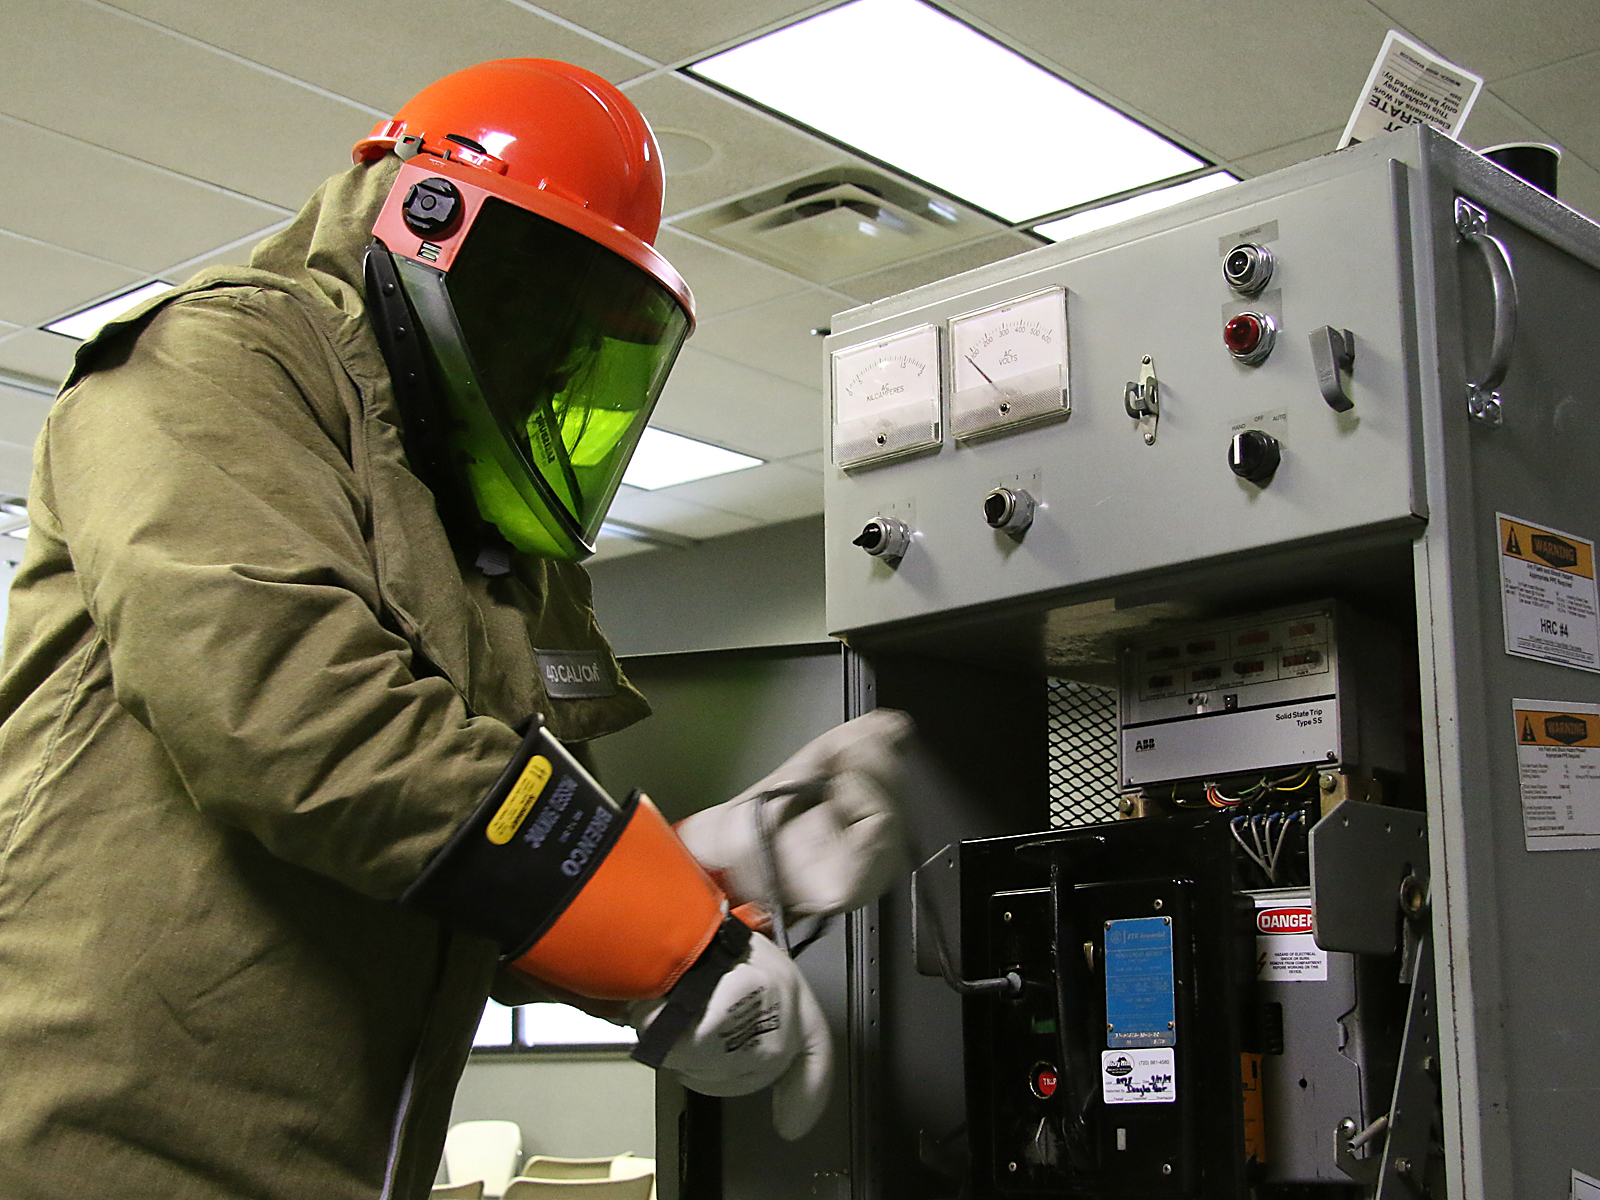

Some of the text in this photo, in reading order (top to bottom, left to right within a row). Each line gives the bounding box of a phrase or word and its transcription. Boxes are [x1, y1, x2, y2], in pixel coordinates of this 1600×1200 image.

[1382, 71, 1458, 114] only be removed by:
[1382, 80, 1449, 119] This lock/tag may
[1373, 86, 1451, 129] Electricians At Work
[971, 348, 980, 359] 100
[983, 336, 993, 347] 200
[999, 328, 1010, 338] 300
[1030, 327, 1040, 337] 500
[1041, 334, 1052, 344] 600
[998, 354, 1018, 366] VOLTS
[1003, 349, 1012, 357] AC
[1231, 423, 1246, 431] HAND
[1272, 413, 1286, 421] AUTO
[1540, 618, 1569, 638] HRC #4
[1275, 712, 1292, 721] Solid
[1292, 710, 1309, 718] State
[1296, 716, 1323, 727] Type SS
[1135, 738, 1155, 751] ABB
